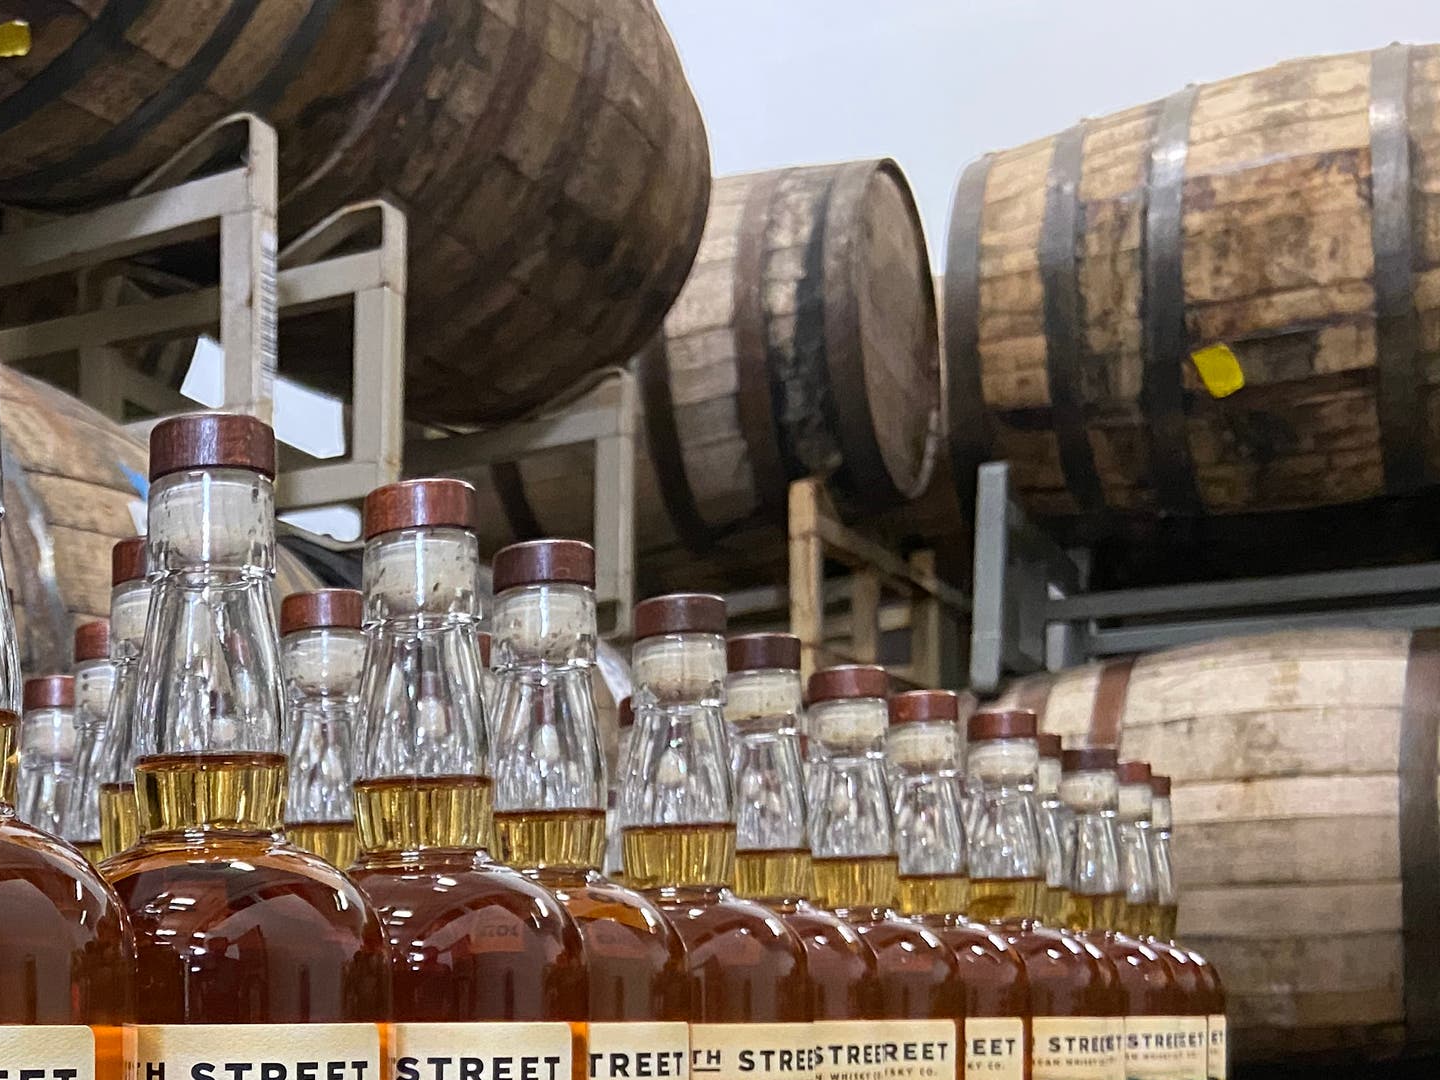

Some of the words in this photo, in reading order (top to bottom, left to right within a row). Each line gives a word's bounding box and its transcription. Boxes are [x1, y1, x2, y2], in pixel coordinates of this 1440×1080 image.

[885, 1043, 948, 1061] REET
[973, 1039, 1015, 1055] EET
[590, 1052, 682, 1077] TREET
